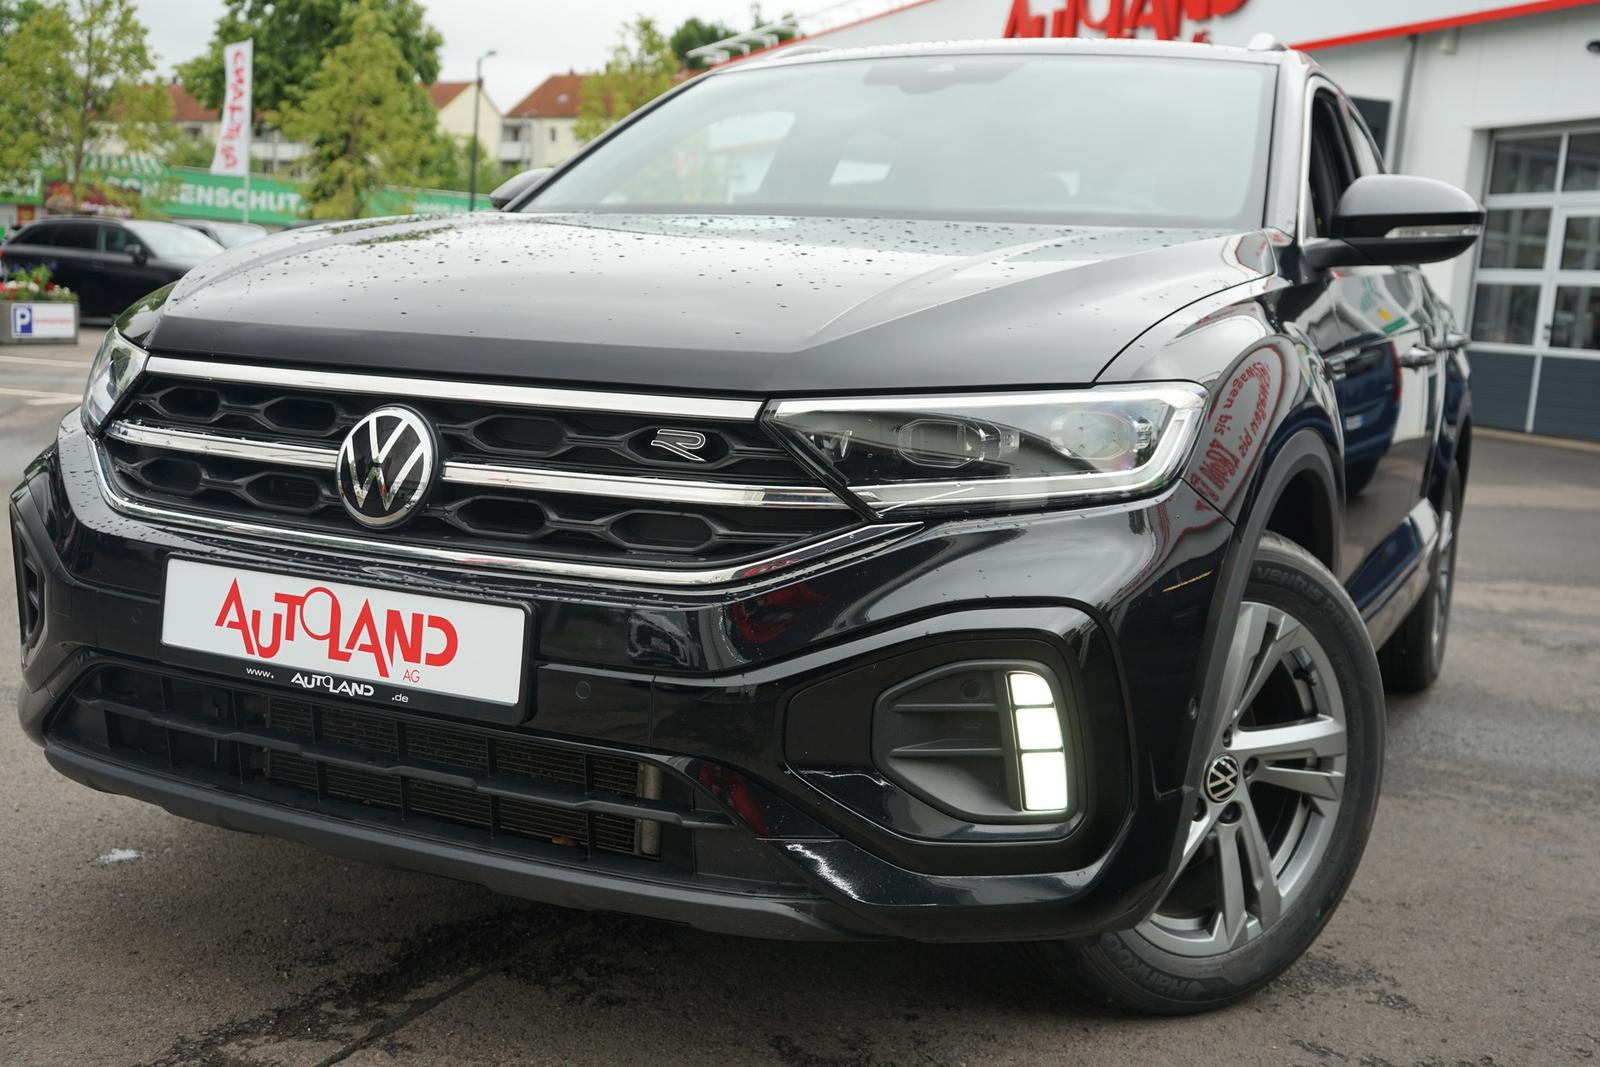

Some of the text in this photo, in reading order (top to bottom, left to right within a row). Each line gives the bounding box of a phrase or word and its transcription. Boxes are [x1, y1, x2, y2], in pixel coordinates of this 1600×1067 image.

[16, 308, 31, 333] P
[651, 428, 706, 462] R
[215, 577, 459, 678] AUTOLAND
[246, 667, 409, 703] www. AUTOLAND .de
[403, 669, 420, 683] AG
